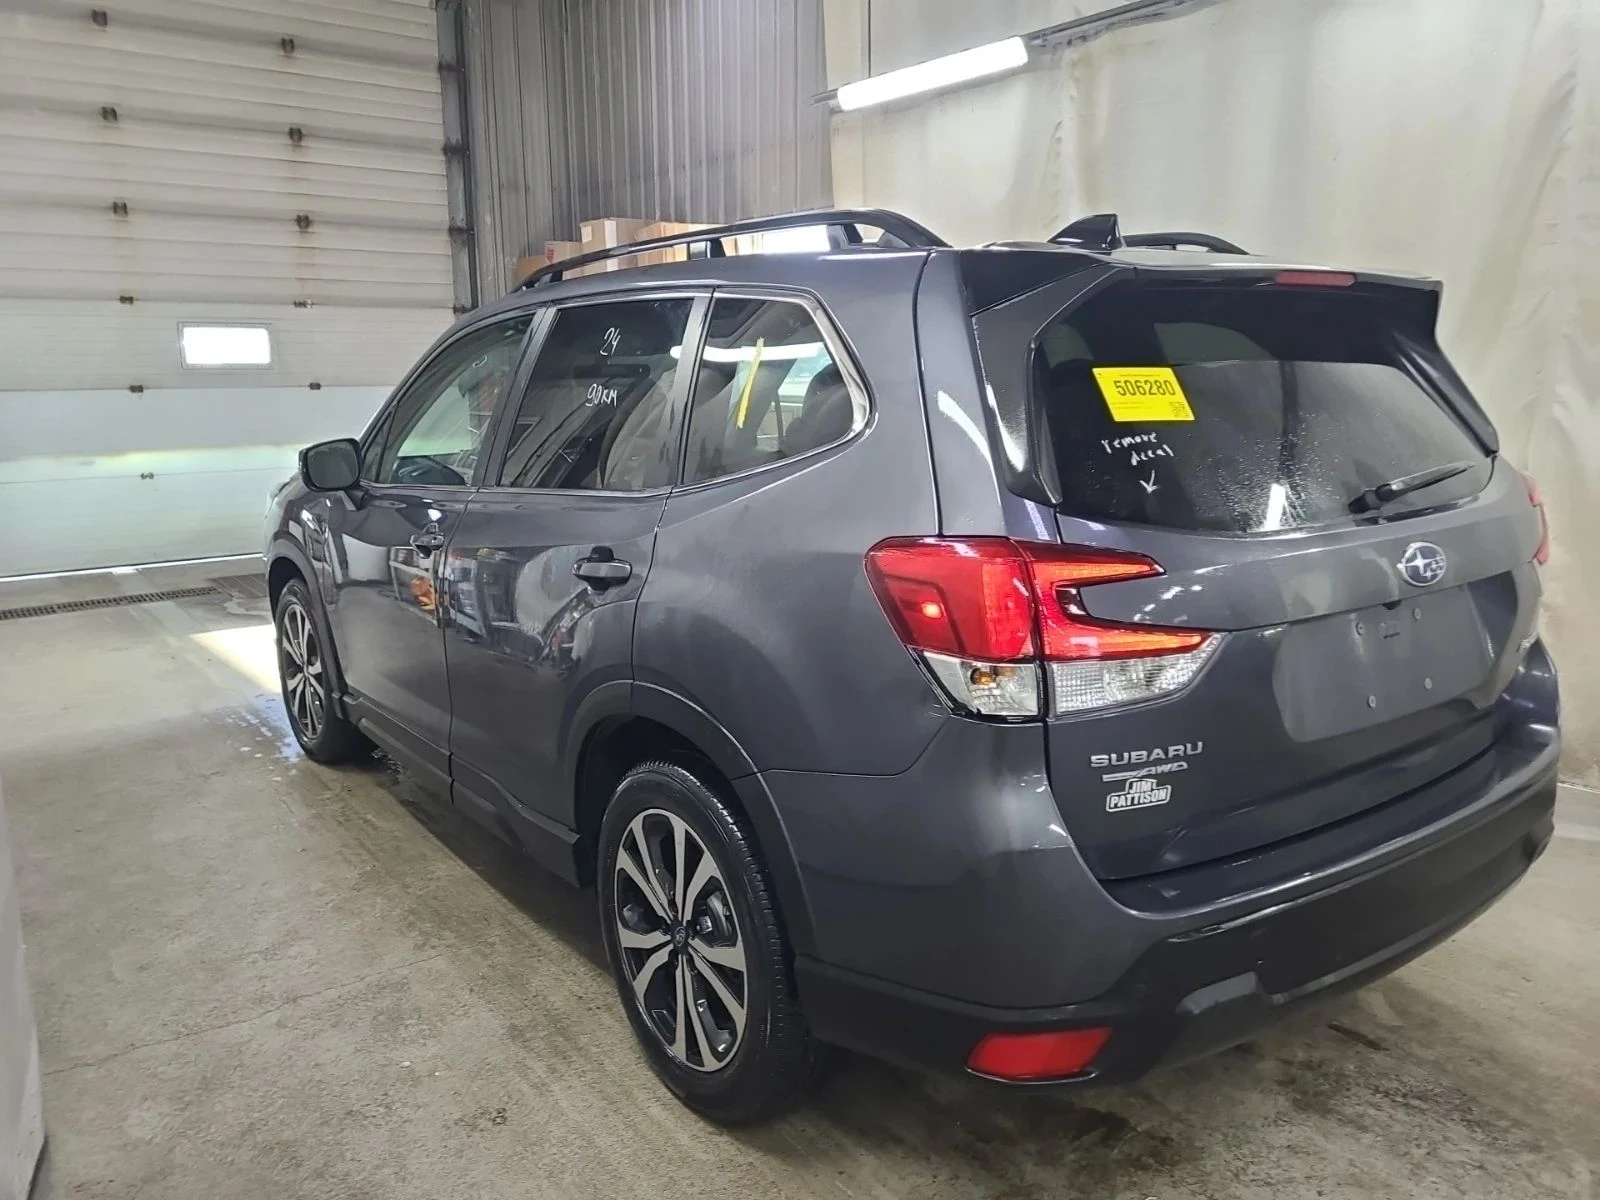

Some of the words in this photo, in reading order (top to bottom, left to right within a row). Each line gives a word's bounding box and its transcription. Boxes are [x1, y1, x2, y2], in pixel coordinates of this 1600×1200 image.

[600, 327, 621, 356] 24
[1113, 379, 1176, 397] 506280
[1090, 741, 1203, 768] SUBARU
[1136, 761, 1188, 777] AWD
[1129, 780, 1152, 794] JIM
[1110, 788, 1168, 808] PATTISON
